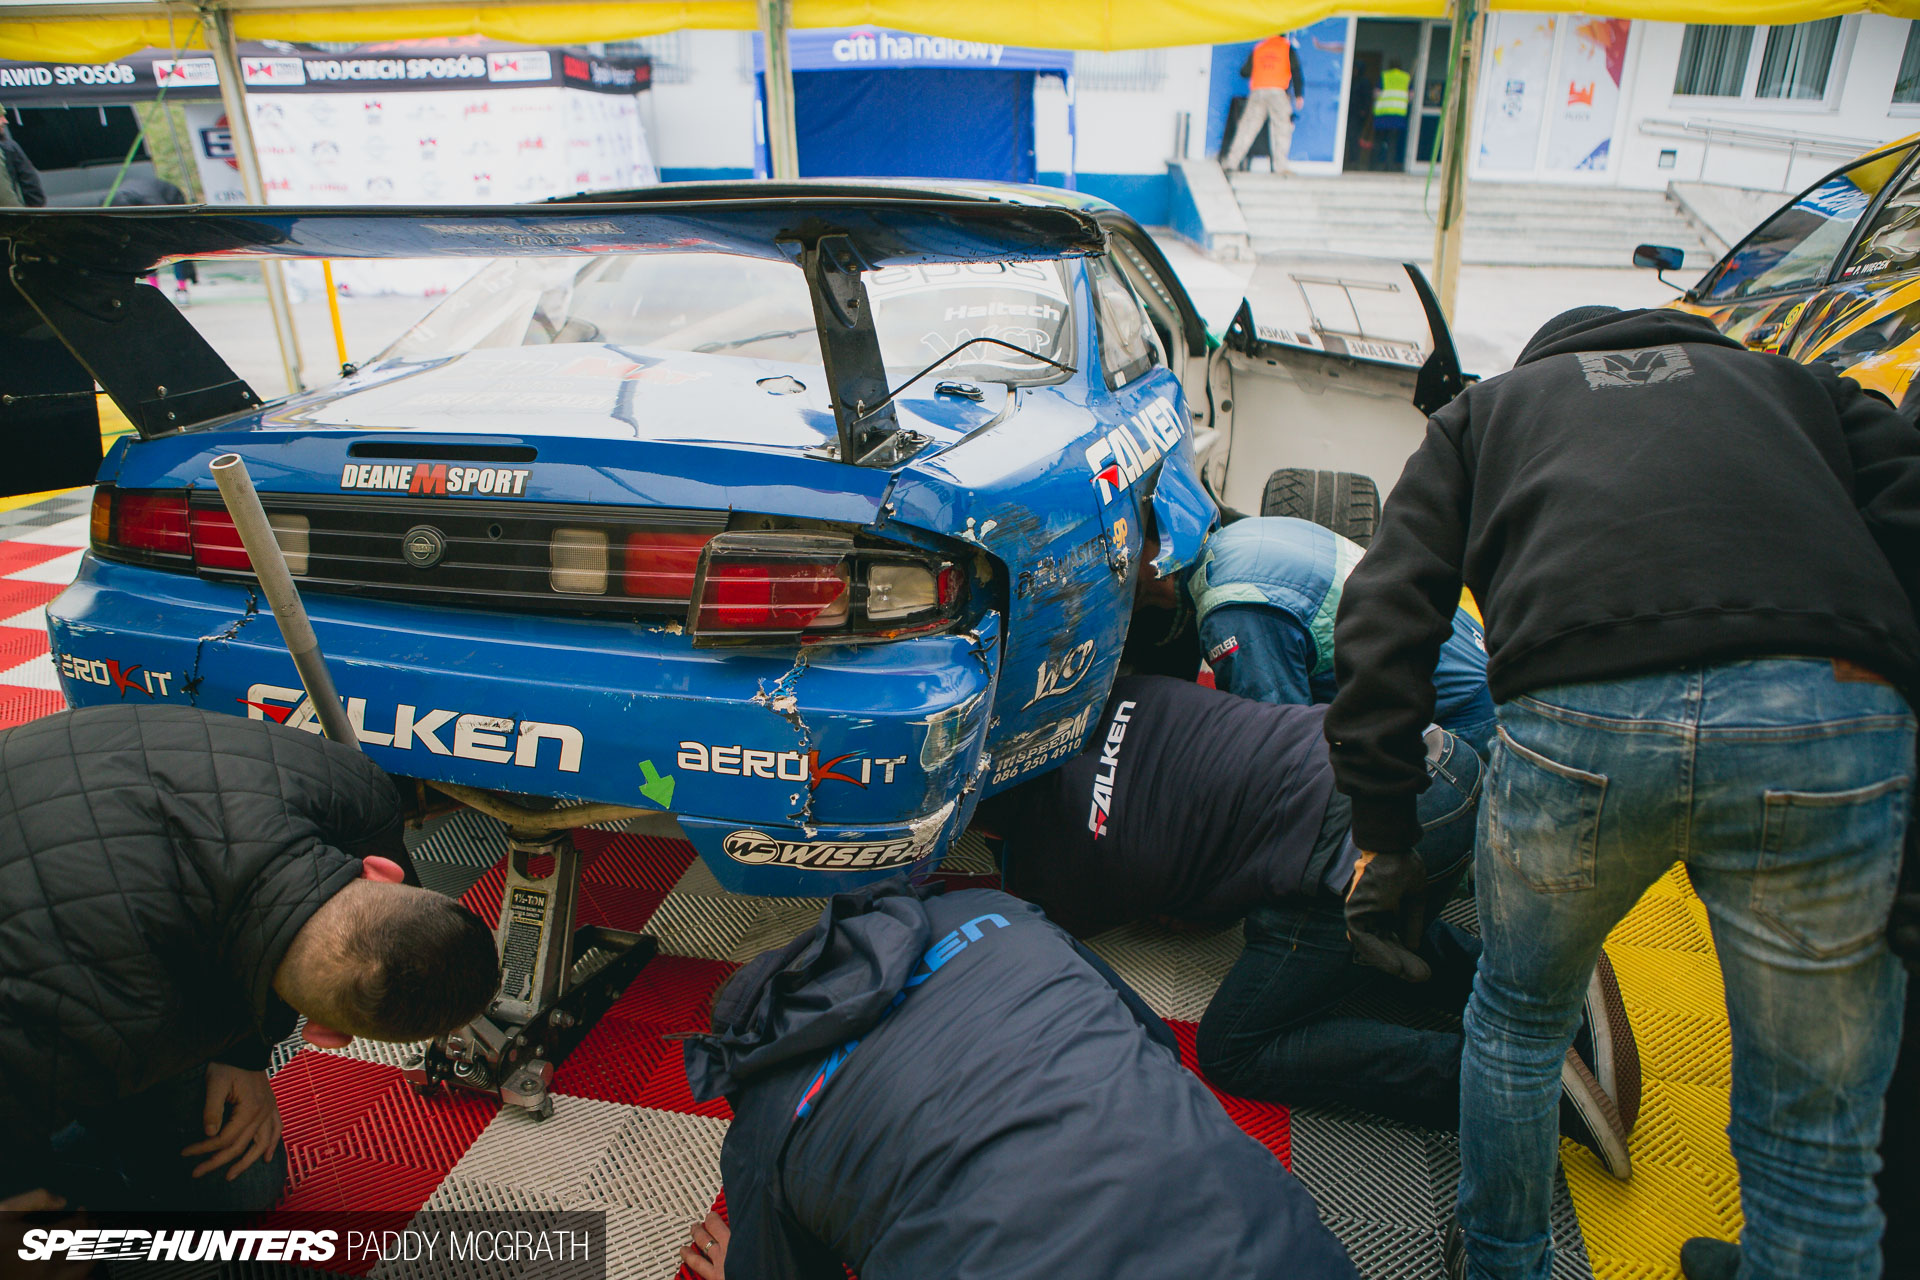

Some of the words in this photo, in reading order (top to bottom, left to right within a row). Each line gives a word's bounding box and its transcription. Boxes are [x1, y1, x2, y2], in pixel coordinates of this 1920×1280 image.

[832, 34, 876, 61] citi
[880, 32, 1003, 66] handlowy
[54, 62, 136, 85] SPOSÓB
[407, 54, 486, 79] SPOSÓB
[944, 302, 1060, 321] Haltech
[1085, 396, 1185, 506] FALKEN
[992, 767, 1018, 785] 086
[1022, 753, 1048, 773] 250
[1051, 737, 1082, 759] 4910
[1088, 700, 1136, 840] FALKEN
